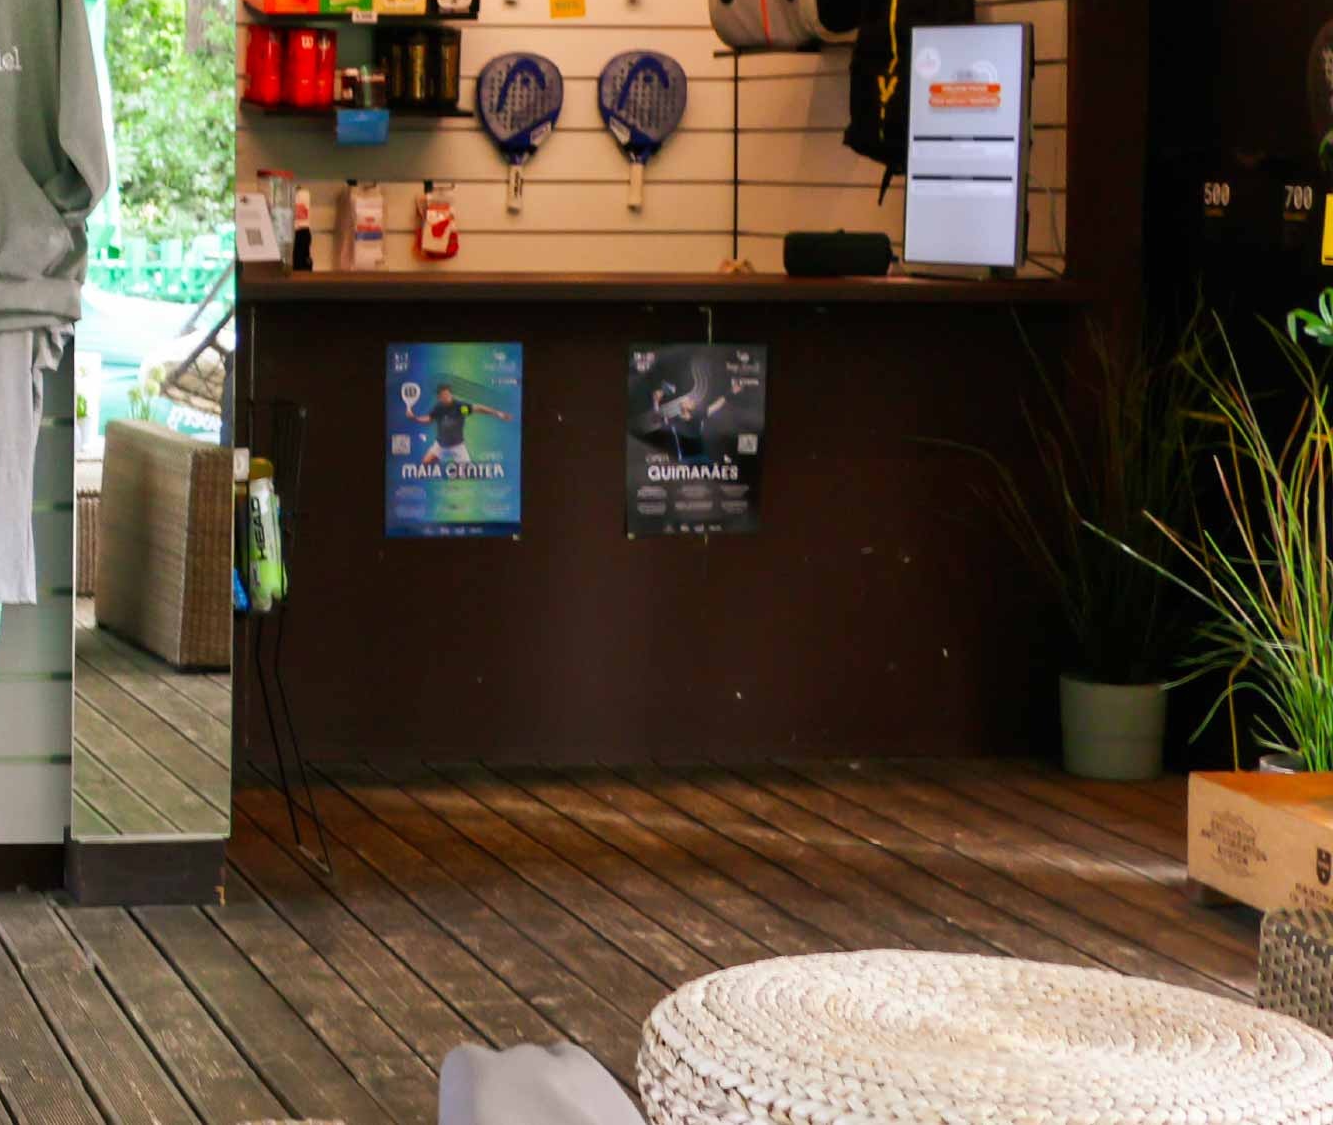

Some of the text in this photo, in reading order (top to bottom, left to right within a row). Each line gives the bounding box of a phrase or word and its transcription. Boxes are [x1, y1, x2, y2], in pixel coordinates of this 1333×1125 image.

[1204, 181, 1230, 207] 500
[1284, 184, 1313, 211] 700
[401, 461, 505, 480] MAIA CENTER
